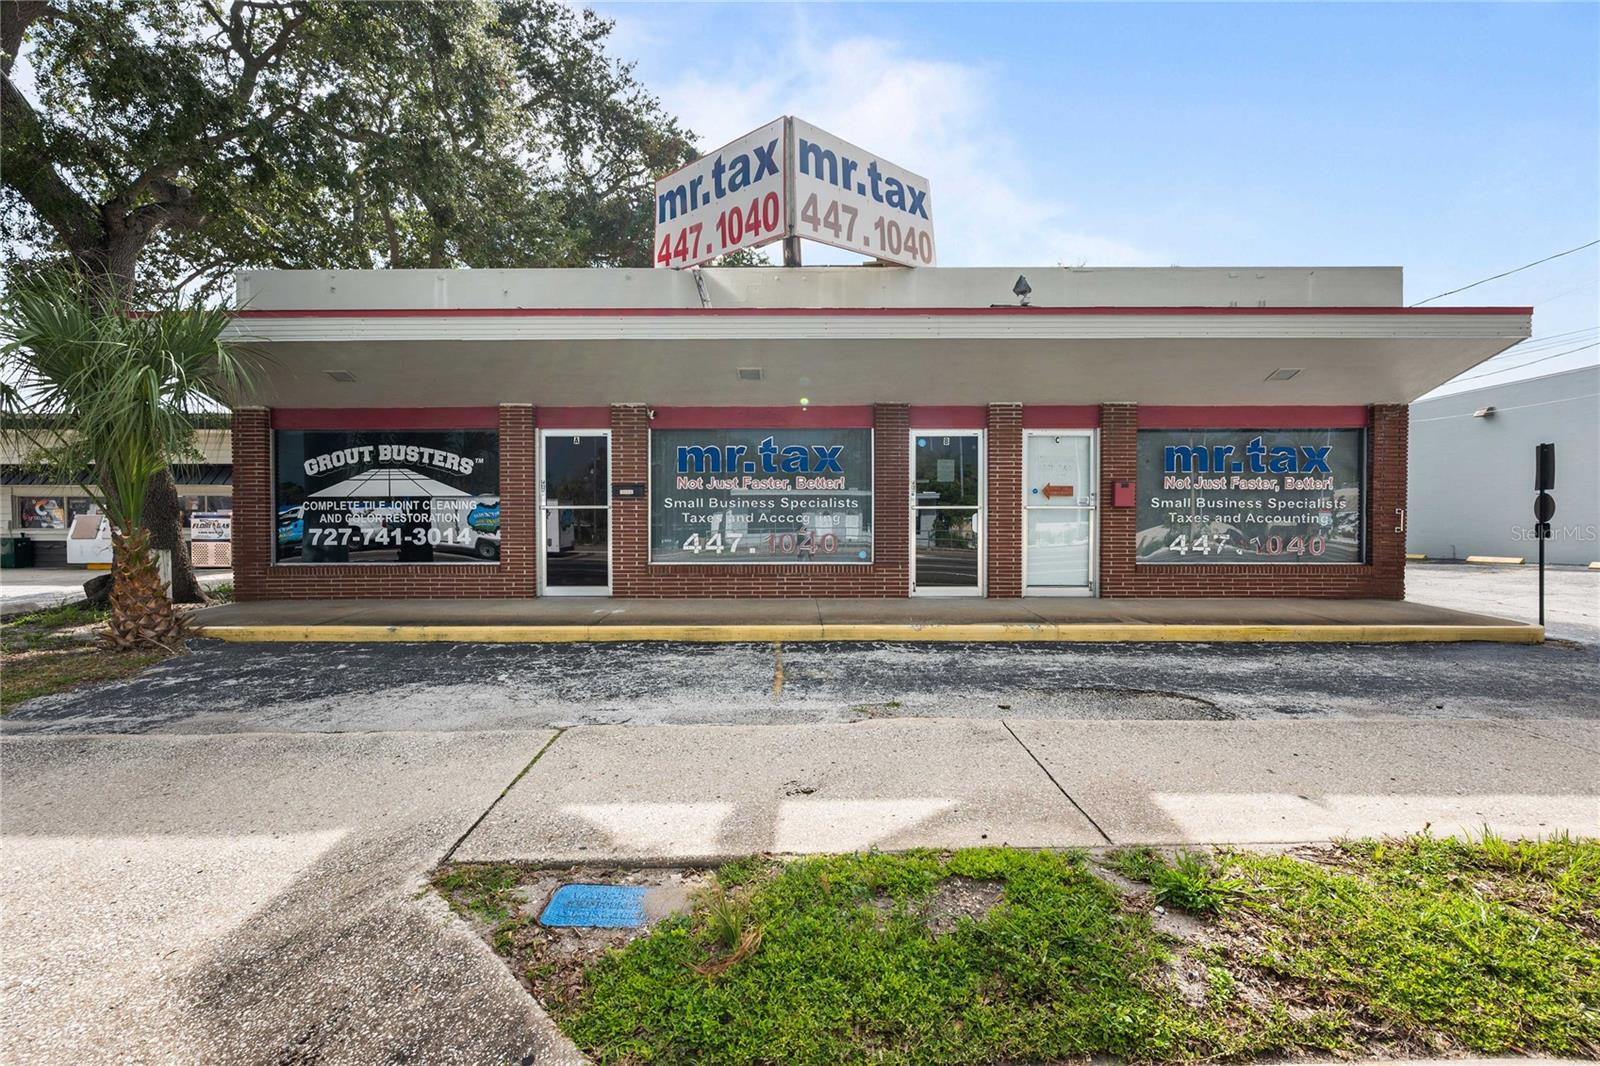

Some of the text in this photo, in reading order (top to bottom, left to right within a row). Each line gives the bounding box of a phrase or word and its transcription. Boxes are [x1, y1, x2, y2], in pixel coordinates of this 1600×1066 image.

[658, 138, 780, 225] mr.tax
[799, 137, 928, 221] mr.tax
[657, 191, 780, 268] 447.1040
[801, 192, 934, 264] 447.1040
[304, 445, 374, 476] GROUT
[378, 445, 475, 475] BUSTERS
[676, 436, 844, 473] mr.tax
[1164, 436, 1332, 473] mr.tax
[677, 476, 845, 491] Not Just Faster, Better!
[1164, 476, 1333, 491] Not Just Faster, Better!
[303, 501, 477, 510] COMPLETE TILE JOINT CLEANING
[664, 498, 859, 510] Small Business Specialists
[1151, 498, 1346, 510] Small Business Specialists
[320, 514, 460, 523] AND COLOR RESTORATION
[1169, 512, 1329, 526] Taxes and Accounting
[308, 528, 472, 546] 727-741-3014
